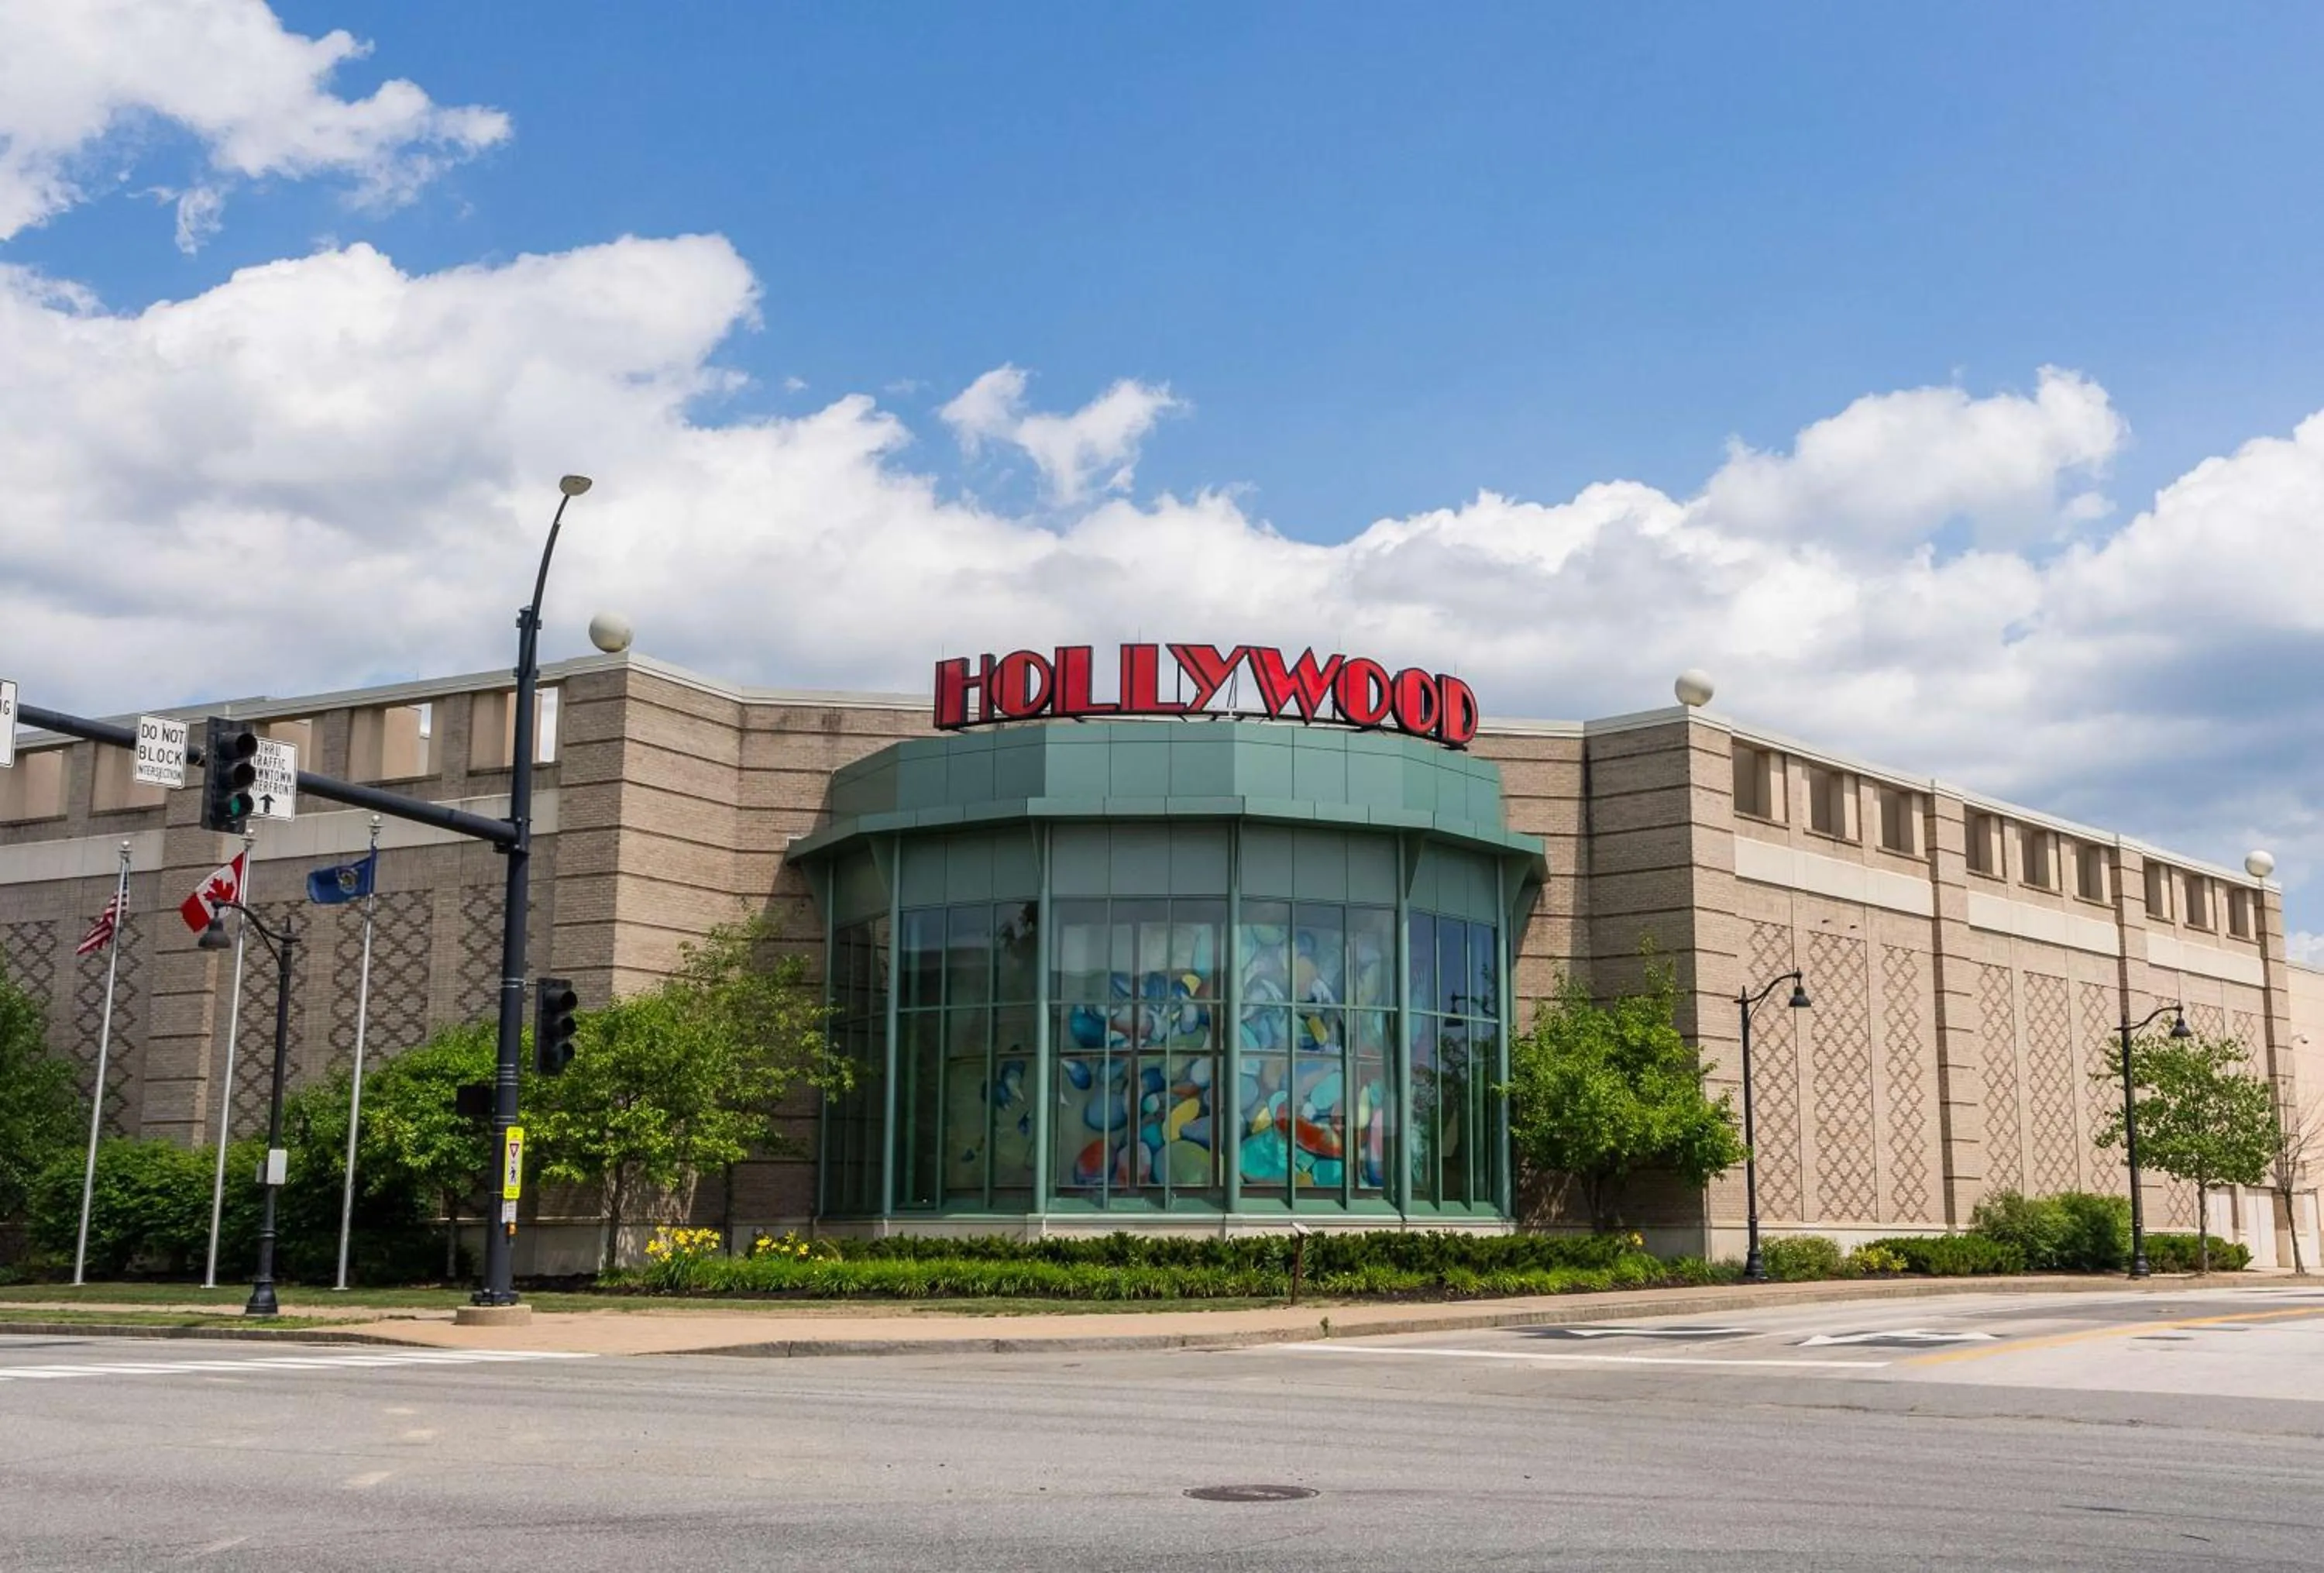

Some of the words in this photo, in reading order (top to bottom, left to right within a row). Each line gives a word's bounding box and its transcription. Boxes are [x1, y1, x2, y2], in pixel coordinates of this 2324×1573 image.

[934, 643, 1479, 745] HOLLYWOOD
[141, 724, 157, 740] DO
[162, 724, 185, 744] NOT
[139, 745, 182, 766] BLOCK
[260, 742, 280, 757] THRU
[258, 768, 292, 784] WNTOWN
